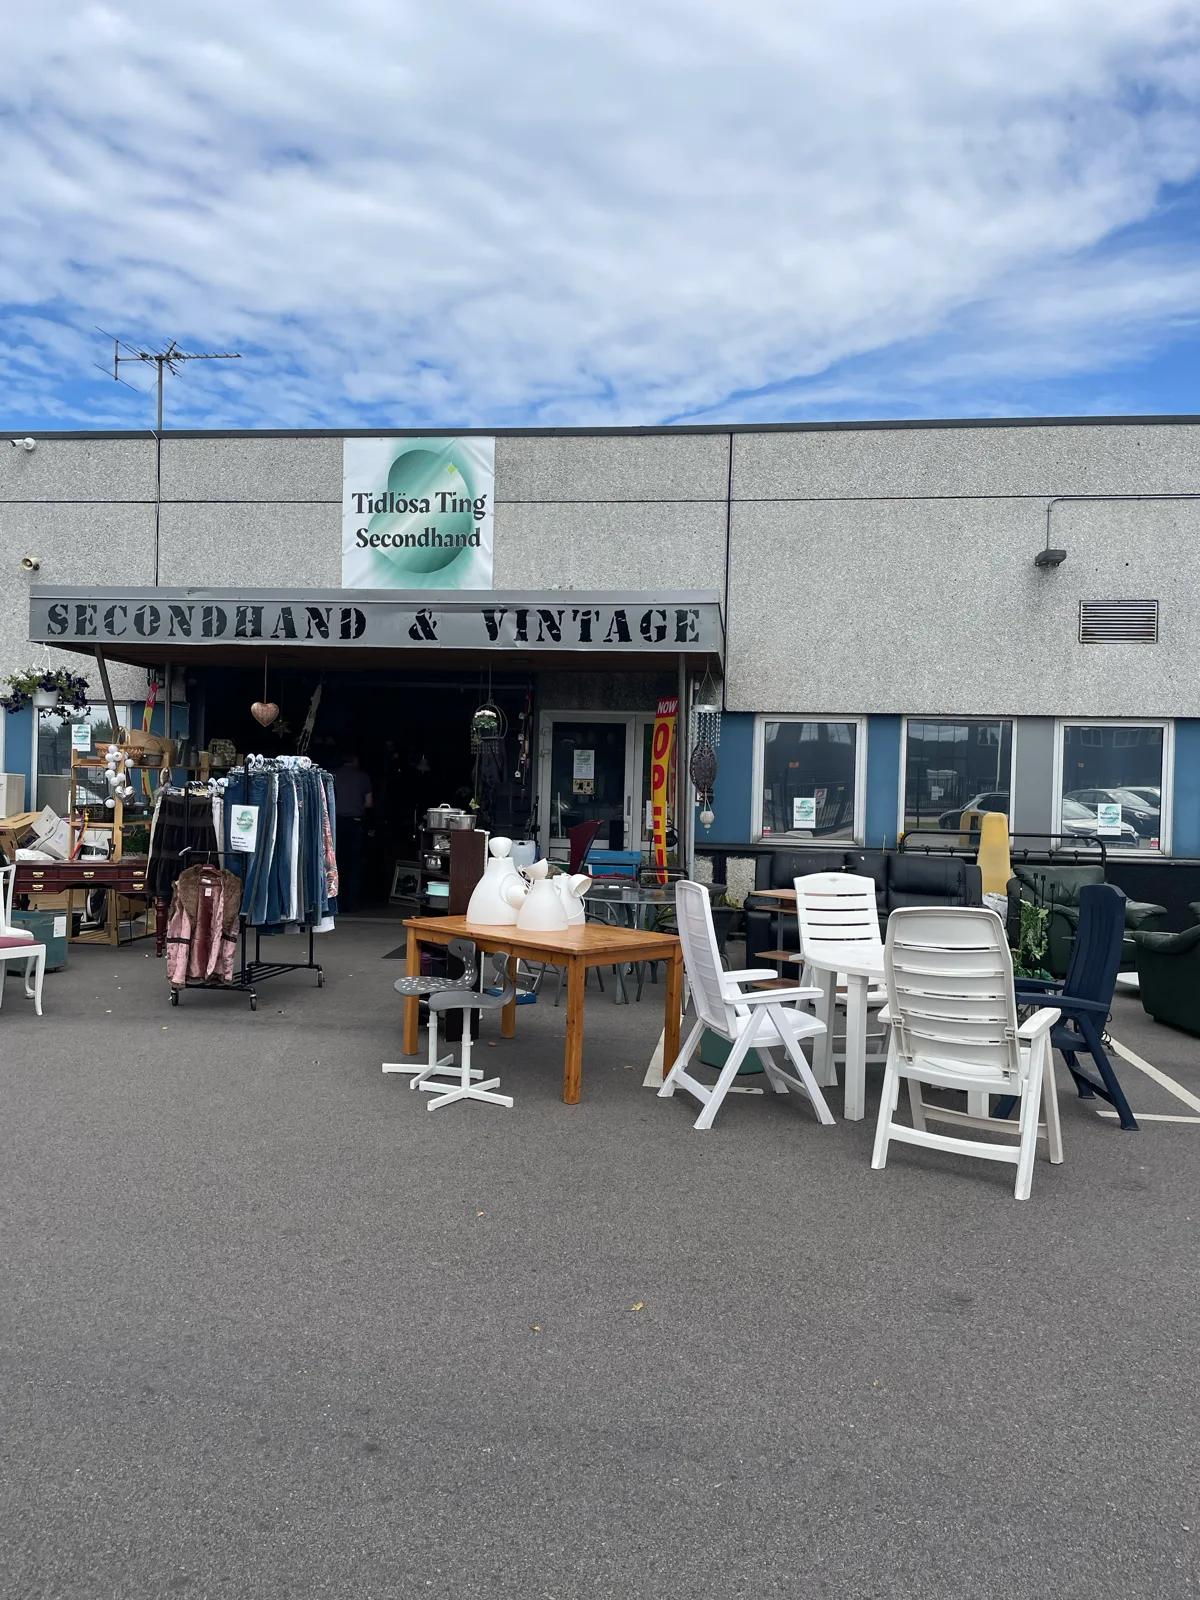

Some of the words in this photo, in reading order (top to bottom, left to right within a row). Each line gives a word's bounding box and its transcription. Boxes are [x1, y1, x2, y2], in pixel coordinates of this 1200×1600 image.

[352, 491, 431, 514] Tidlösa
[434, 491, 487, 521] Ting
[355, 527, 481, 548] Secondhand
[47, 603, 367, 640] SECONDHAND
[408, 608, 439, 641] &
[481, 608, 700, 643] VINTAGE
[657, 700, 678, 713] NOW
